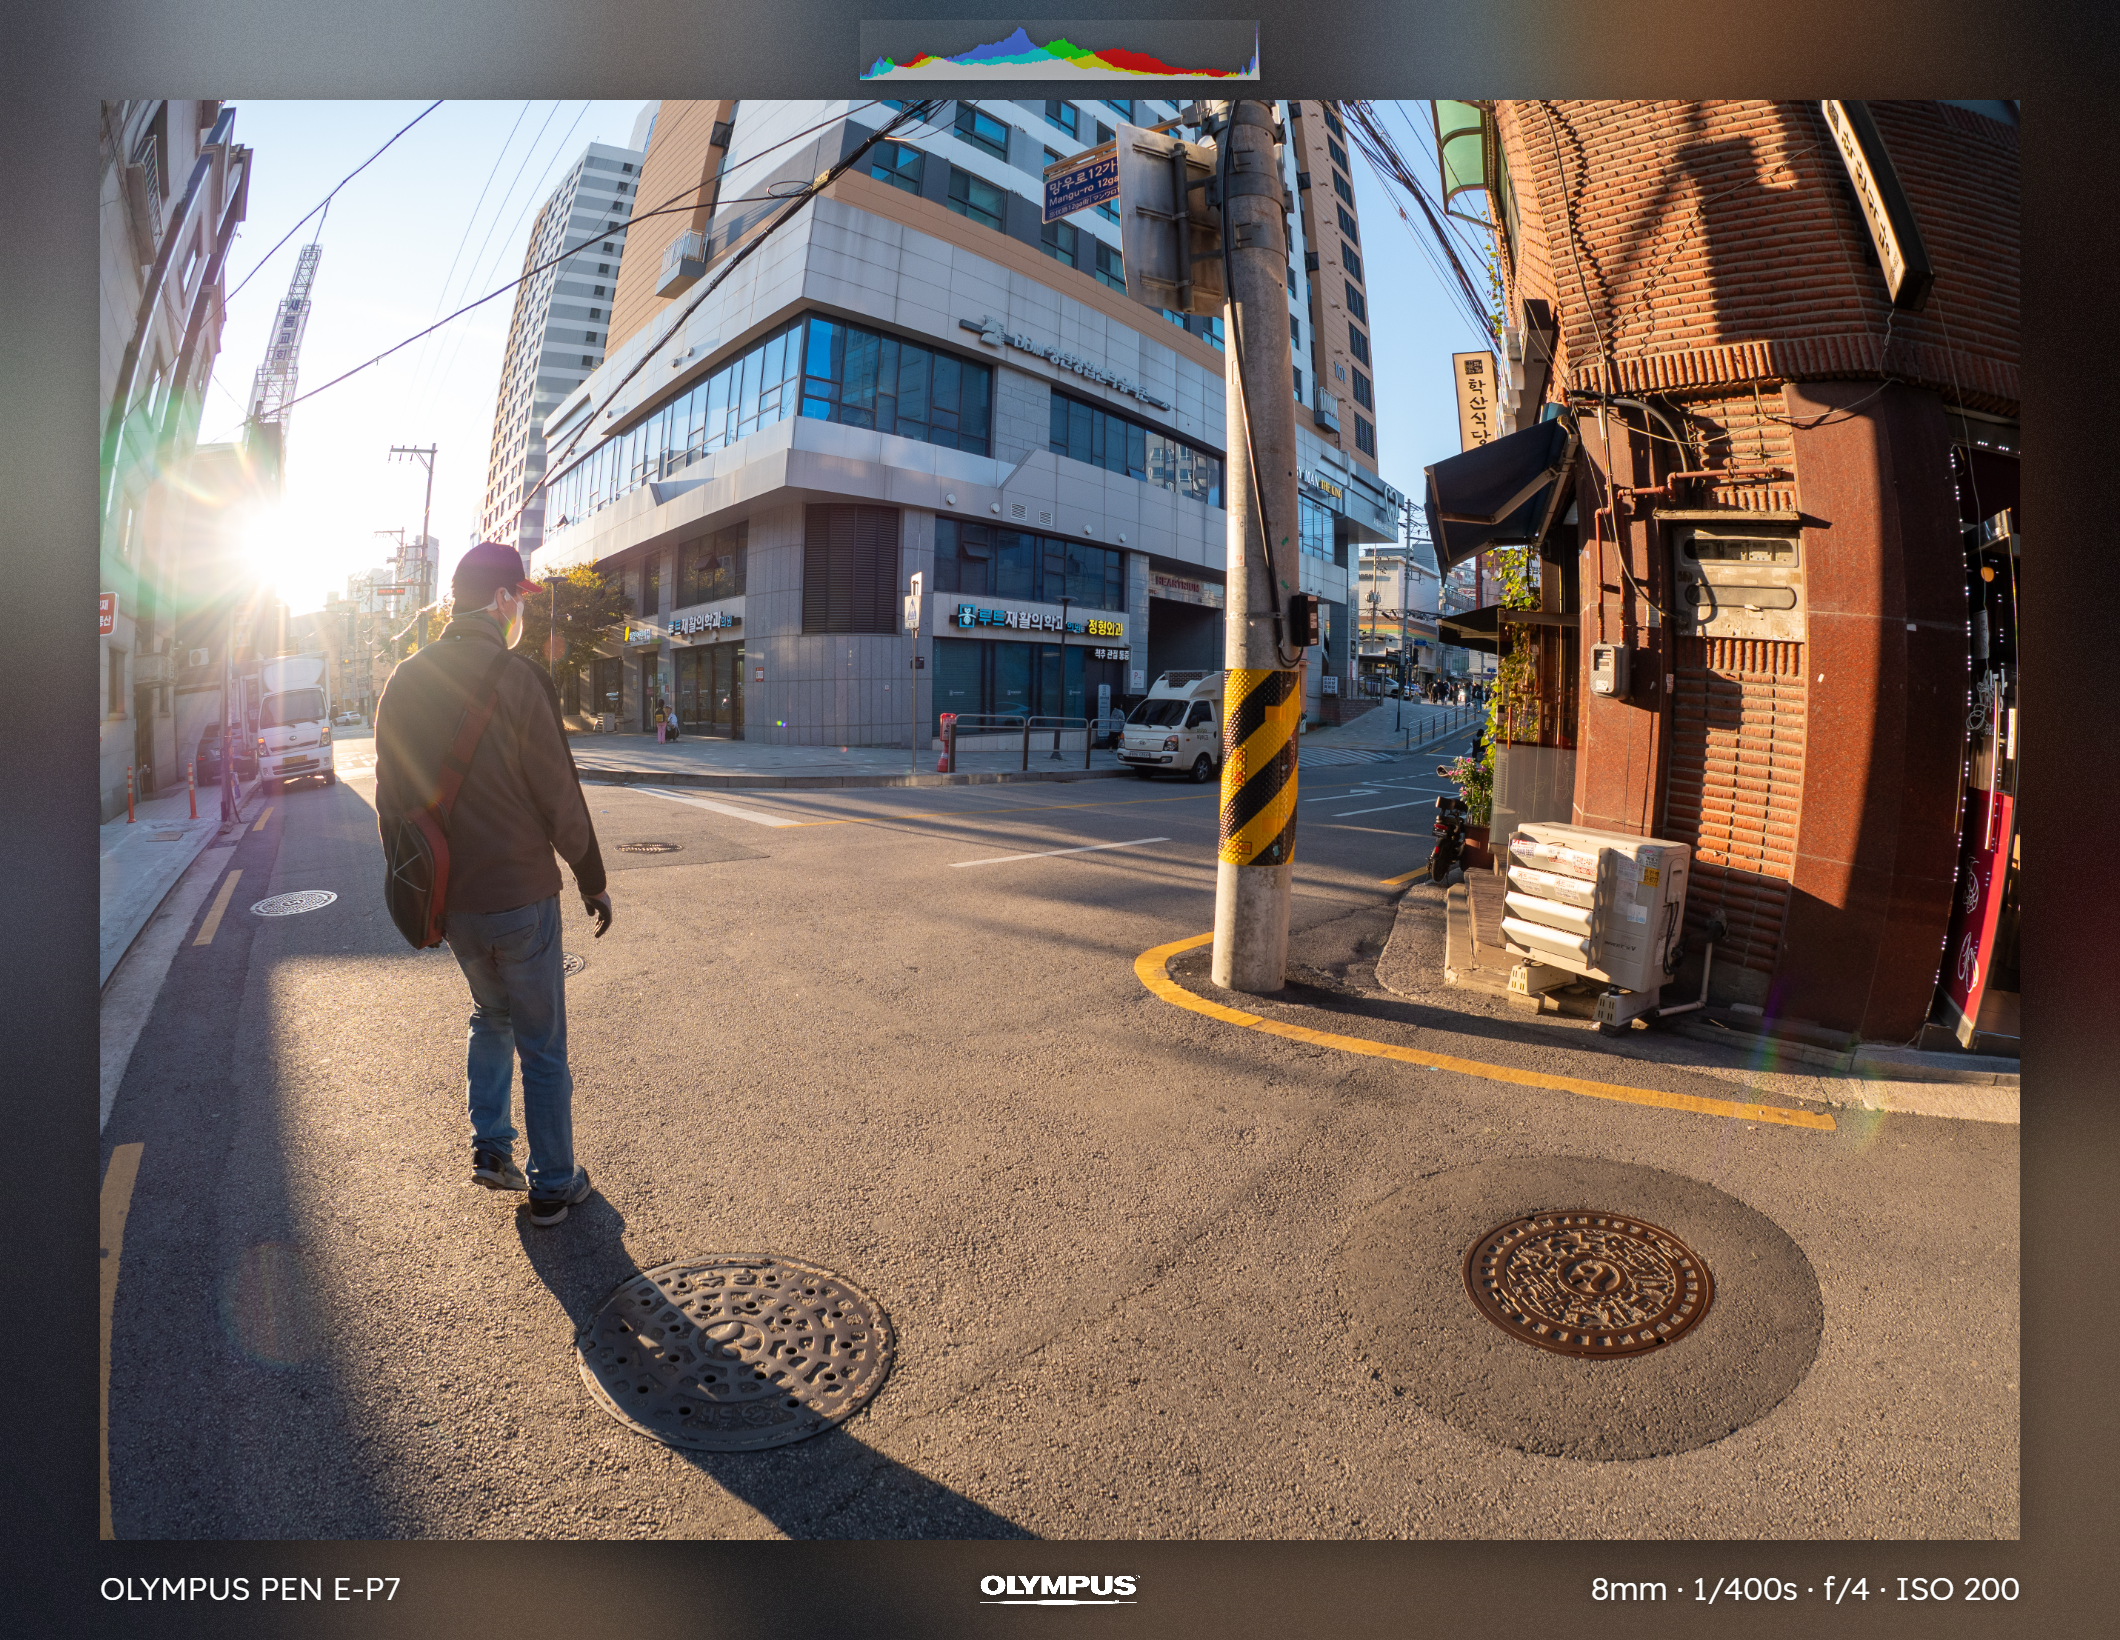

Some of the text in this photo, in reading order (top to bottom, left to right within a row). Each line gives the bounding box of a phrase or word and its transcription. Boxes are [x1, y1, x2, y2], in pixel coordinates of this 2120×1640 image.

[1049, 159, 1118, 195] 망우로12가
[1049, 184, 1094, 206] Mangu-ro
[1014, 333, 1045, 357] DDM
[1334, 361, 1346, 384] 101
[1468, 378, 1492, 446] 학산식당
[1304, 469, 1320, 488] MAN
[1320, 479, 1331, 494] THE
[1088, 619, 1123, 637] 정형외과
